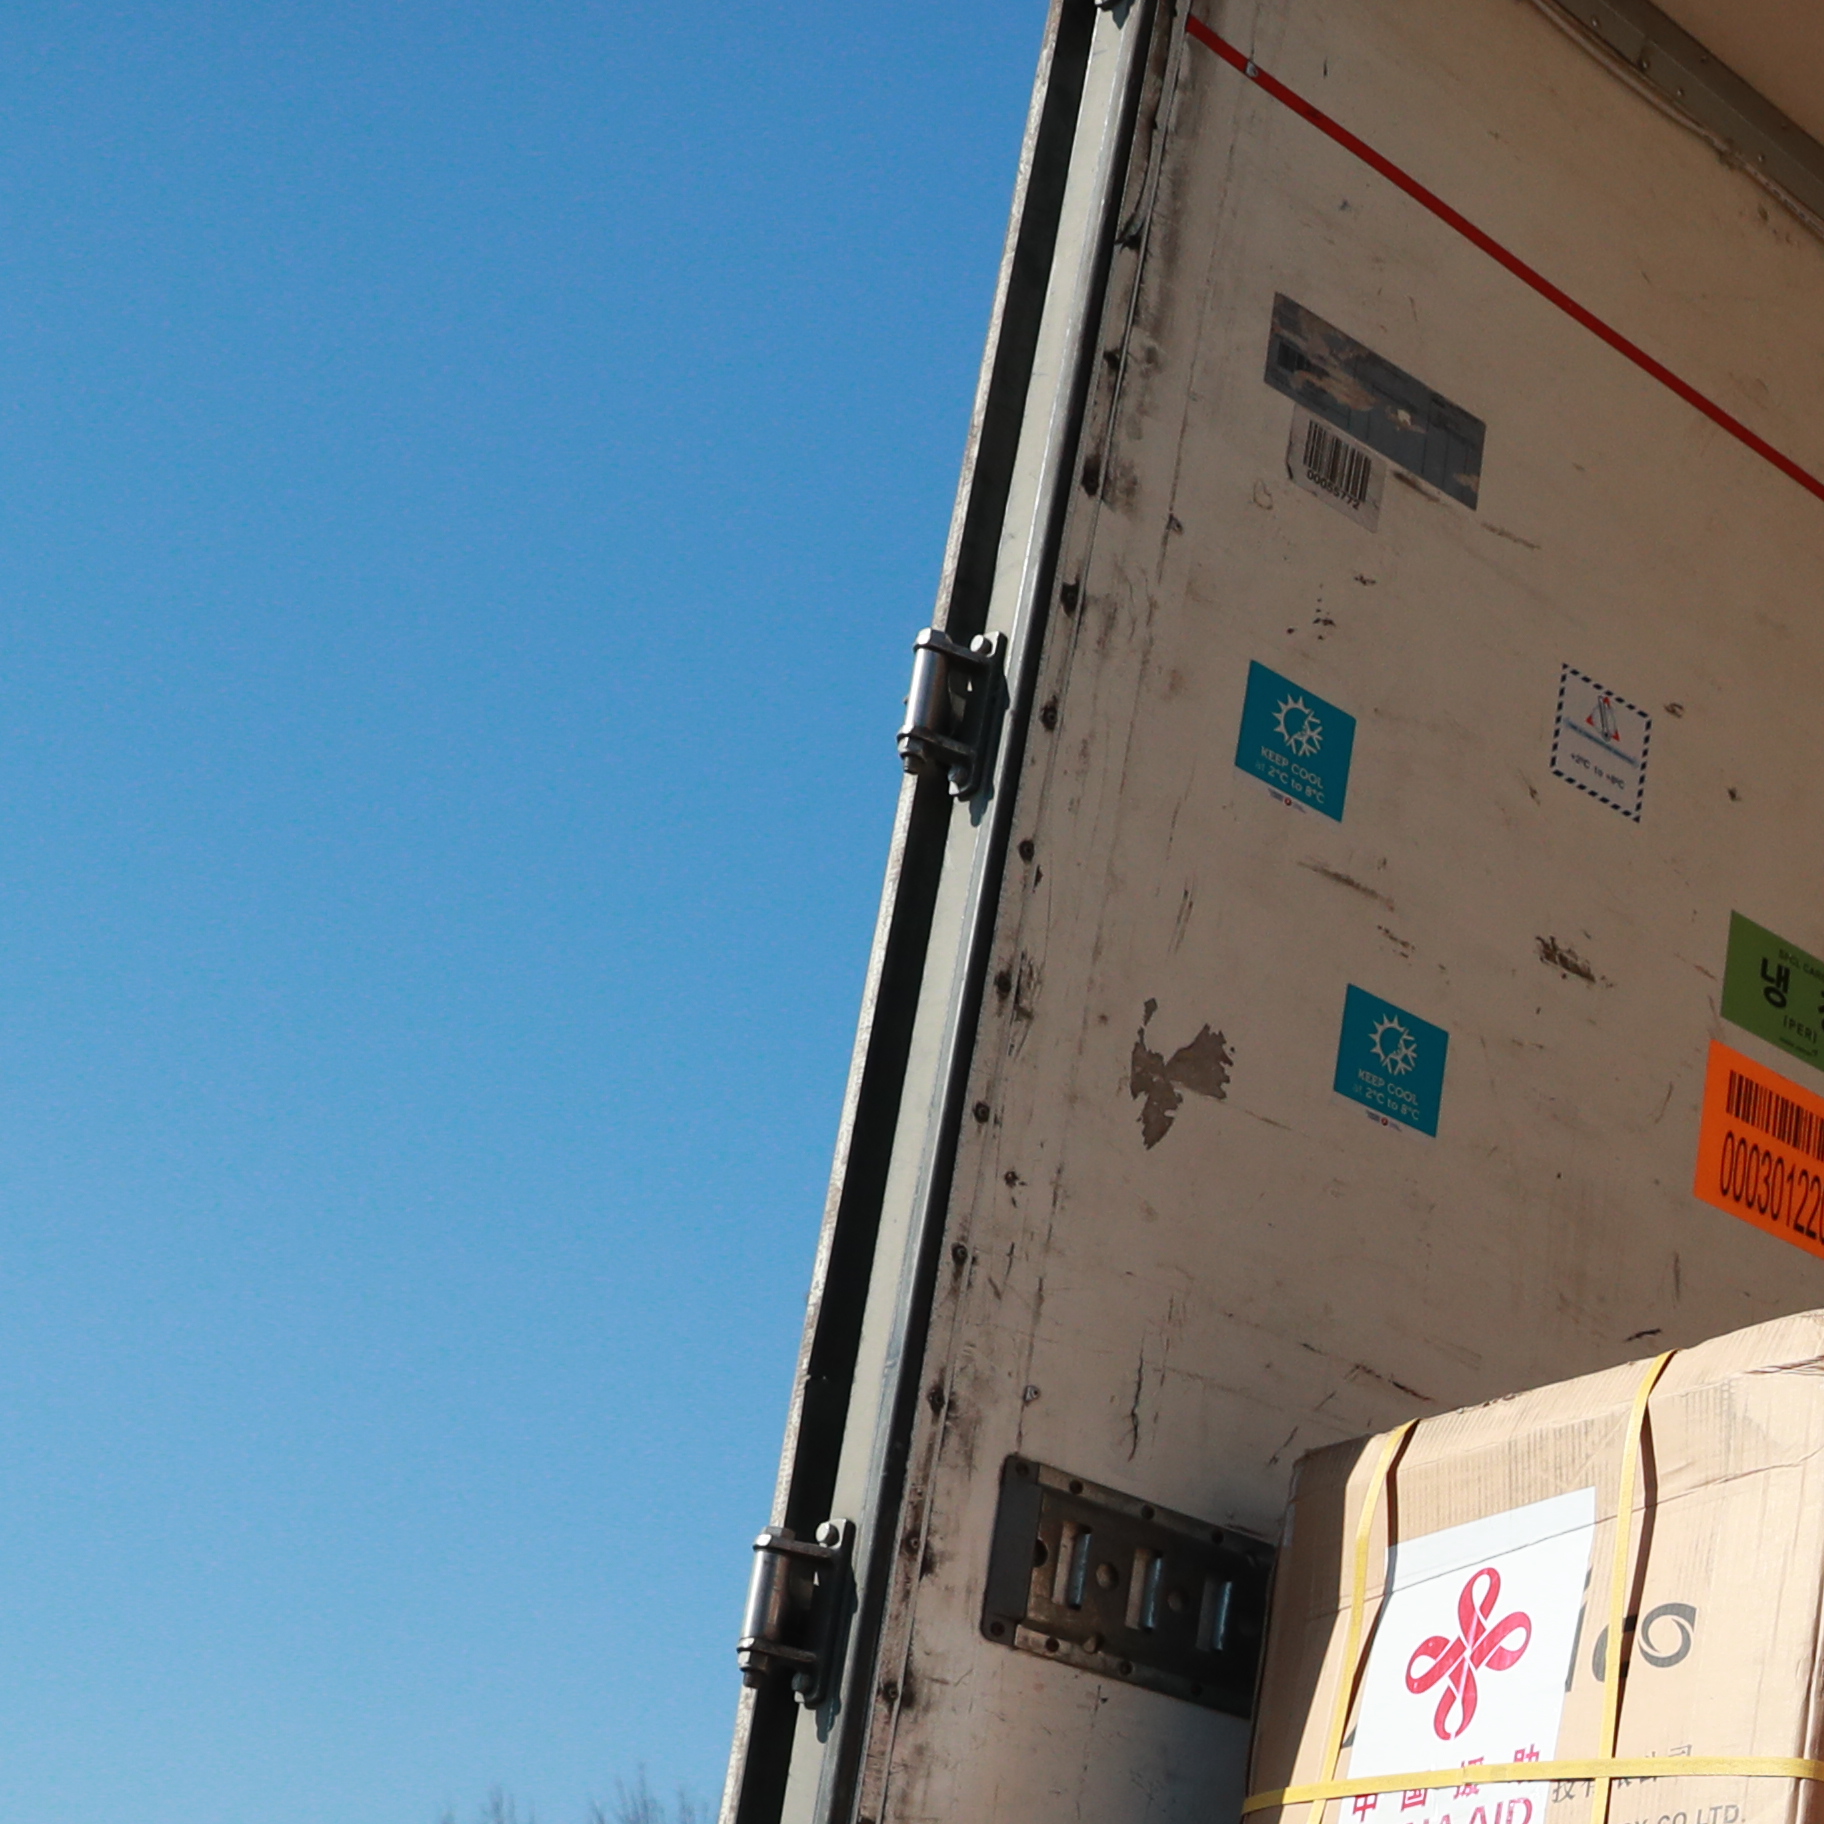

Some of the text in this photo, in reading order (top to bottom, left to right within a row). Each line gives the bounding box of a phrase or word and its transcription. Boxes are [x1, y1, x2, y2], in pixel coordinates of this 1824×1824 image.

[1261, 746, 1324, 789] KEEP COOL
[1291, 778, 1302, 791] to
[1358, 1068, 1419, 1106] KEEP COOL
[1388, 1099, 1398, 1111] to
